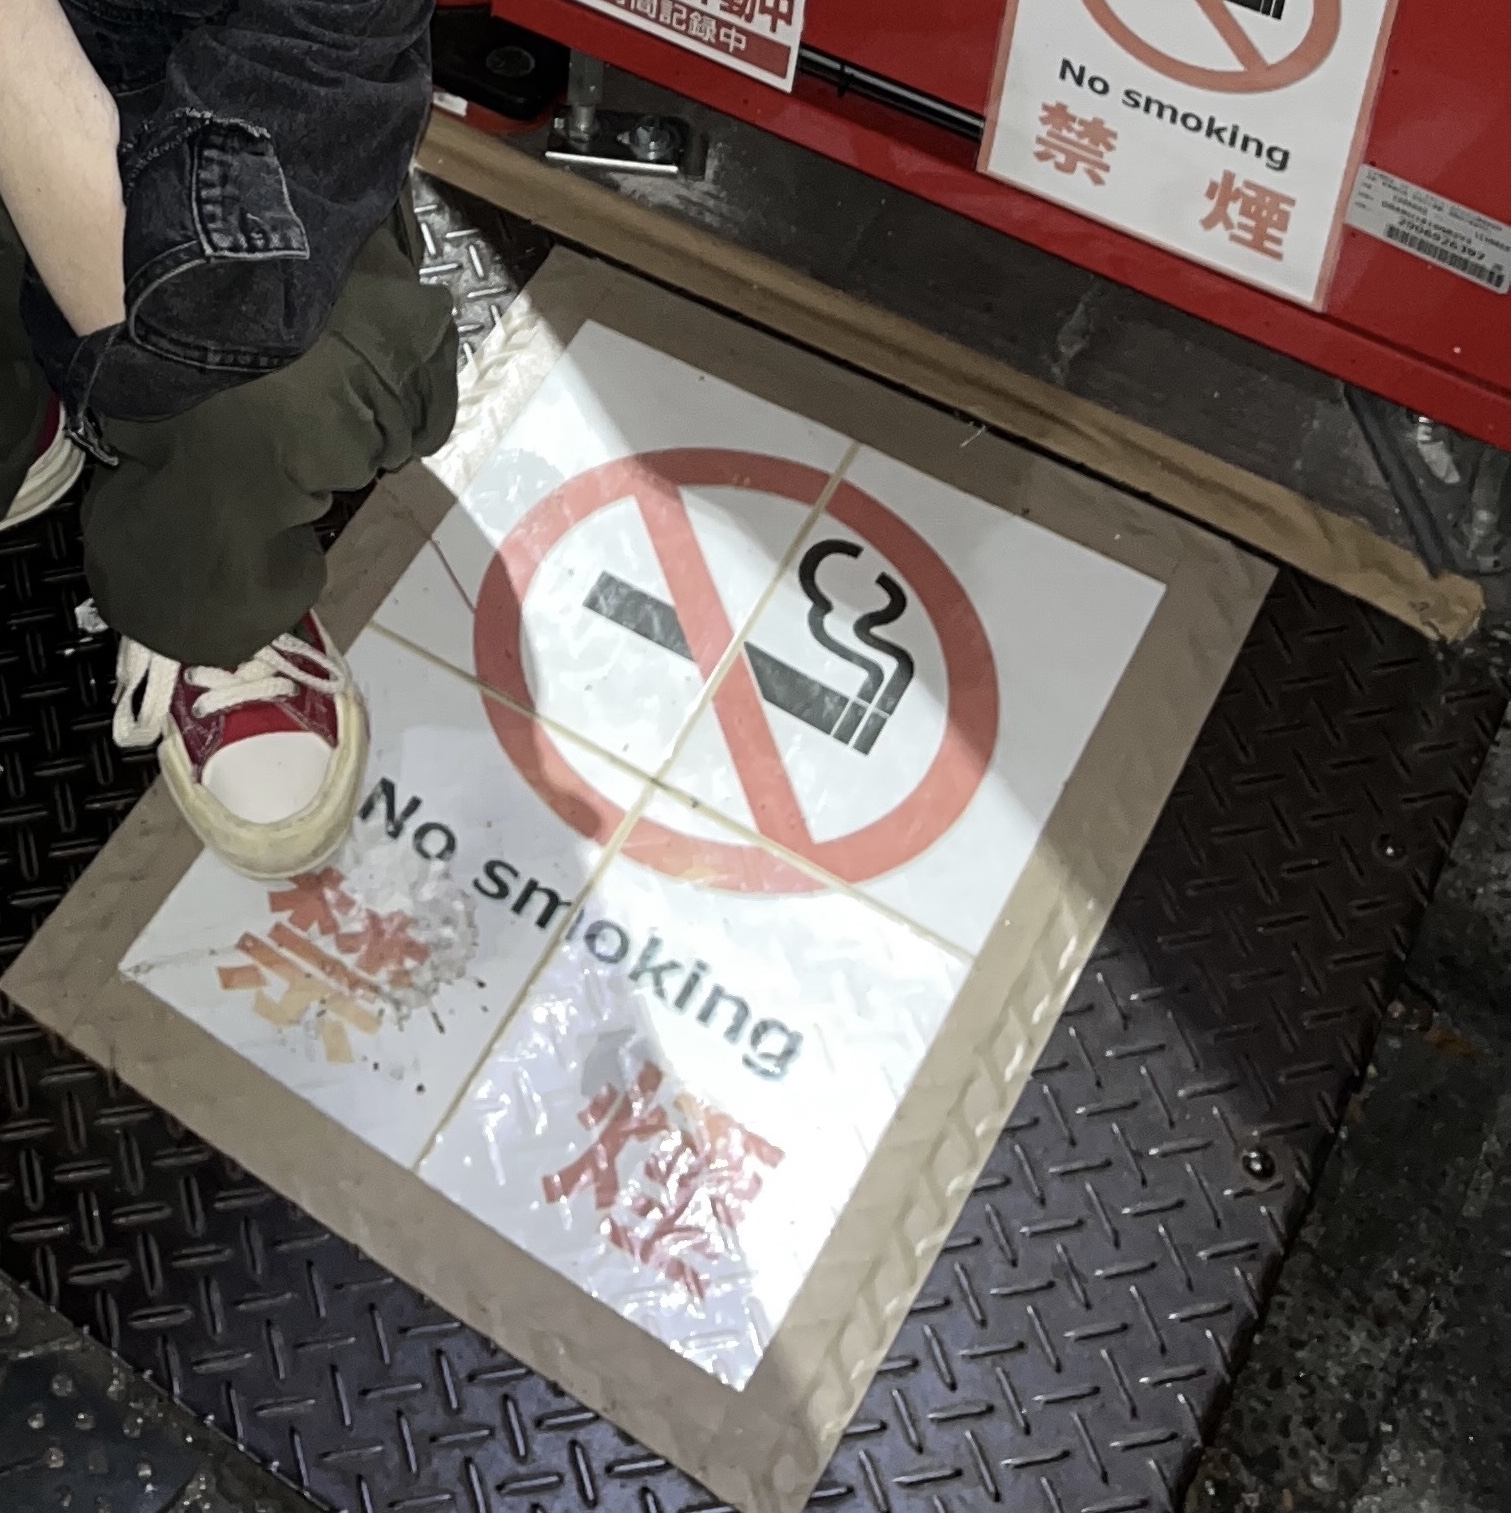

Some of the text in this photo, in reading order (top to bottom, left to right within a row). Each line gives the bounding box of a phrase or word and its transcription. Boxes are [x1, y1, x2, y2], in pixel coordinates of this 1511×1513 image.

[1033, 100, 1119, 187] 禁
[1199, 168, 1297, 263] 煙
[1057, 58, 1292, 172] No smoking
[356, 777, 805, 1082] No smoking
